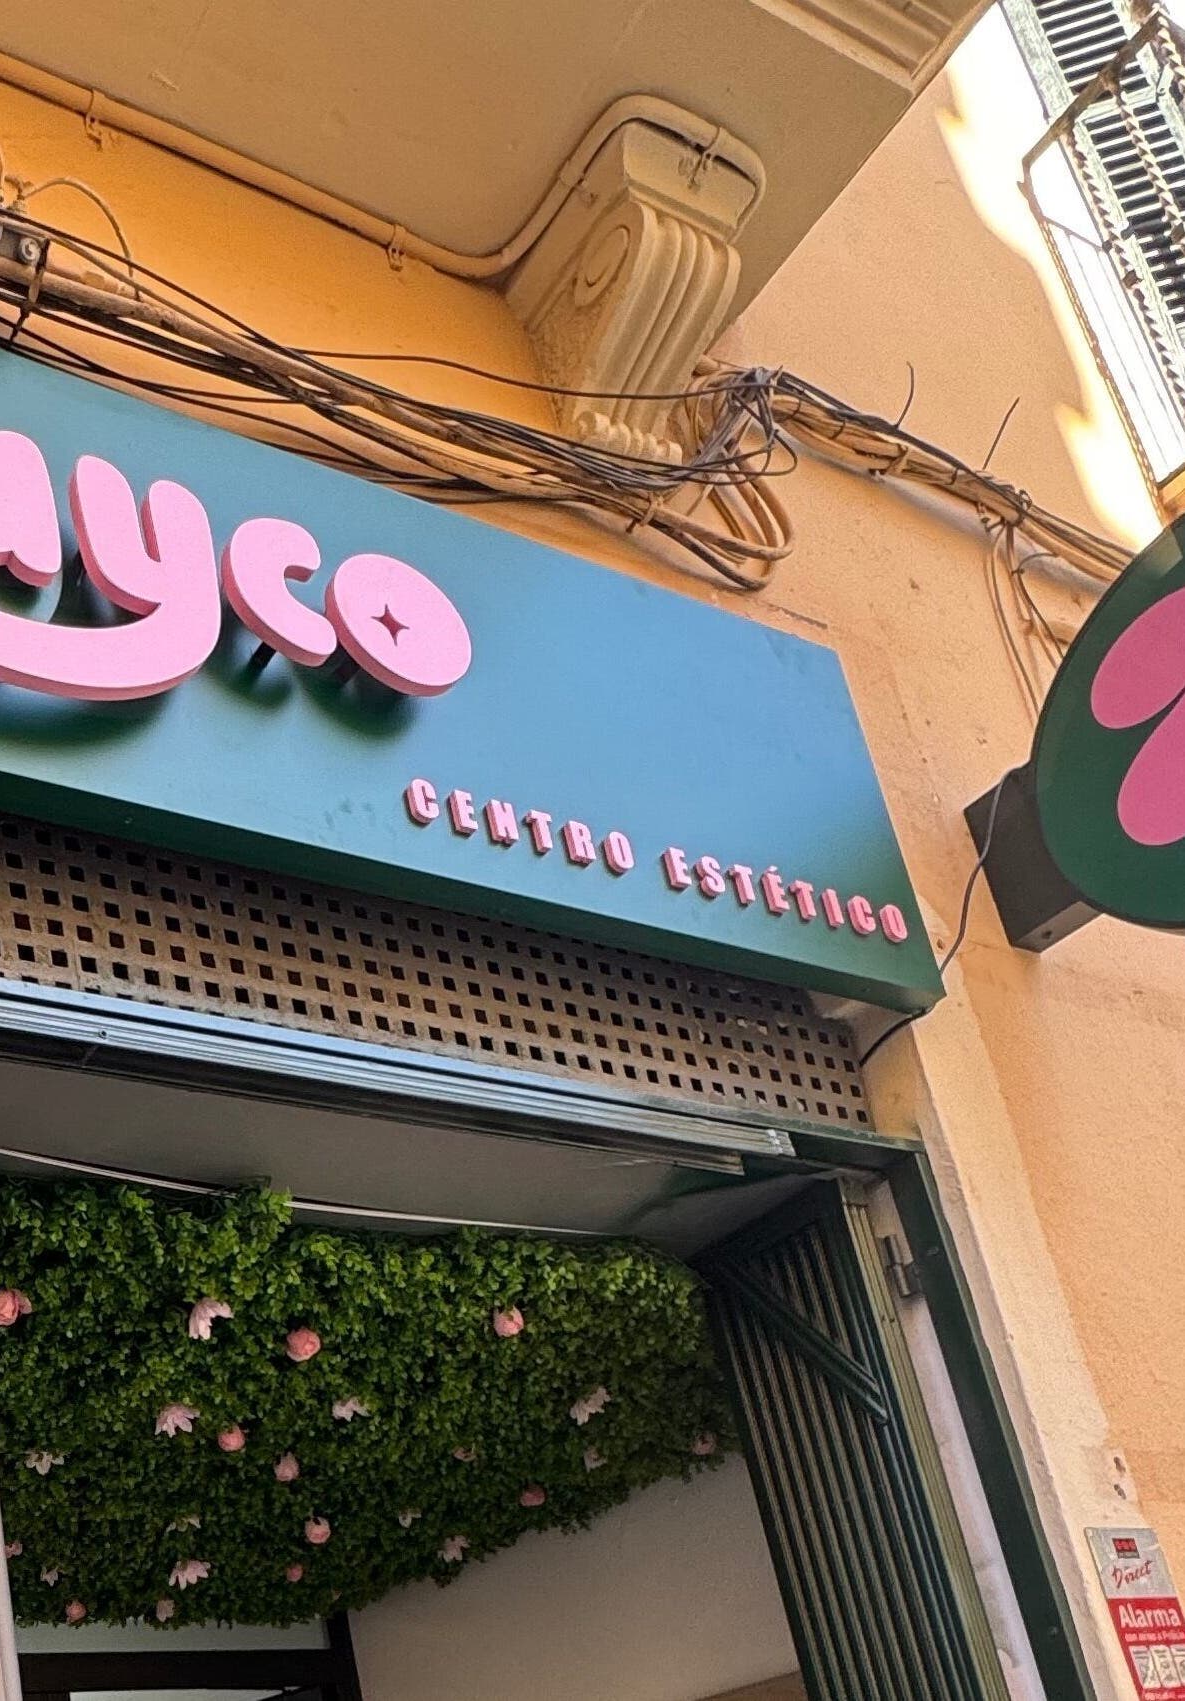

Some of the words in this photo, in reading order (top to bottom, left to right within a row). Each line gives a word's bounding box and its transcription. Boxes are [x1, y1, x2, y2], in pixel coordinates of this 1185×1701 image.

[406, 778, 636, 874] CENTRO
[663, 845, 909, 944] ESTÉTICO
[1119, 1602, 1182, 1629] Alarma
